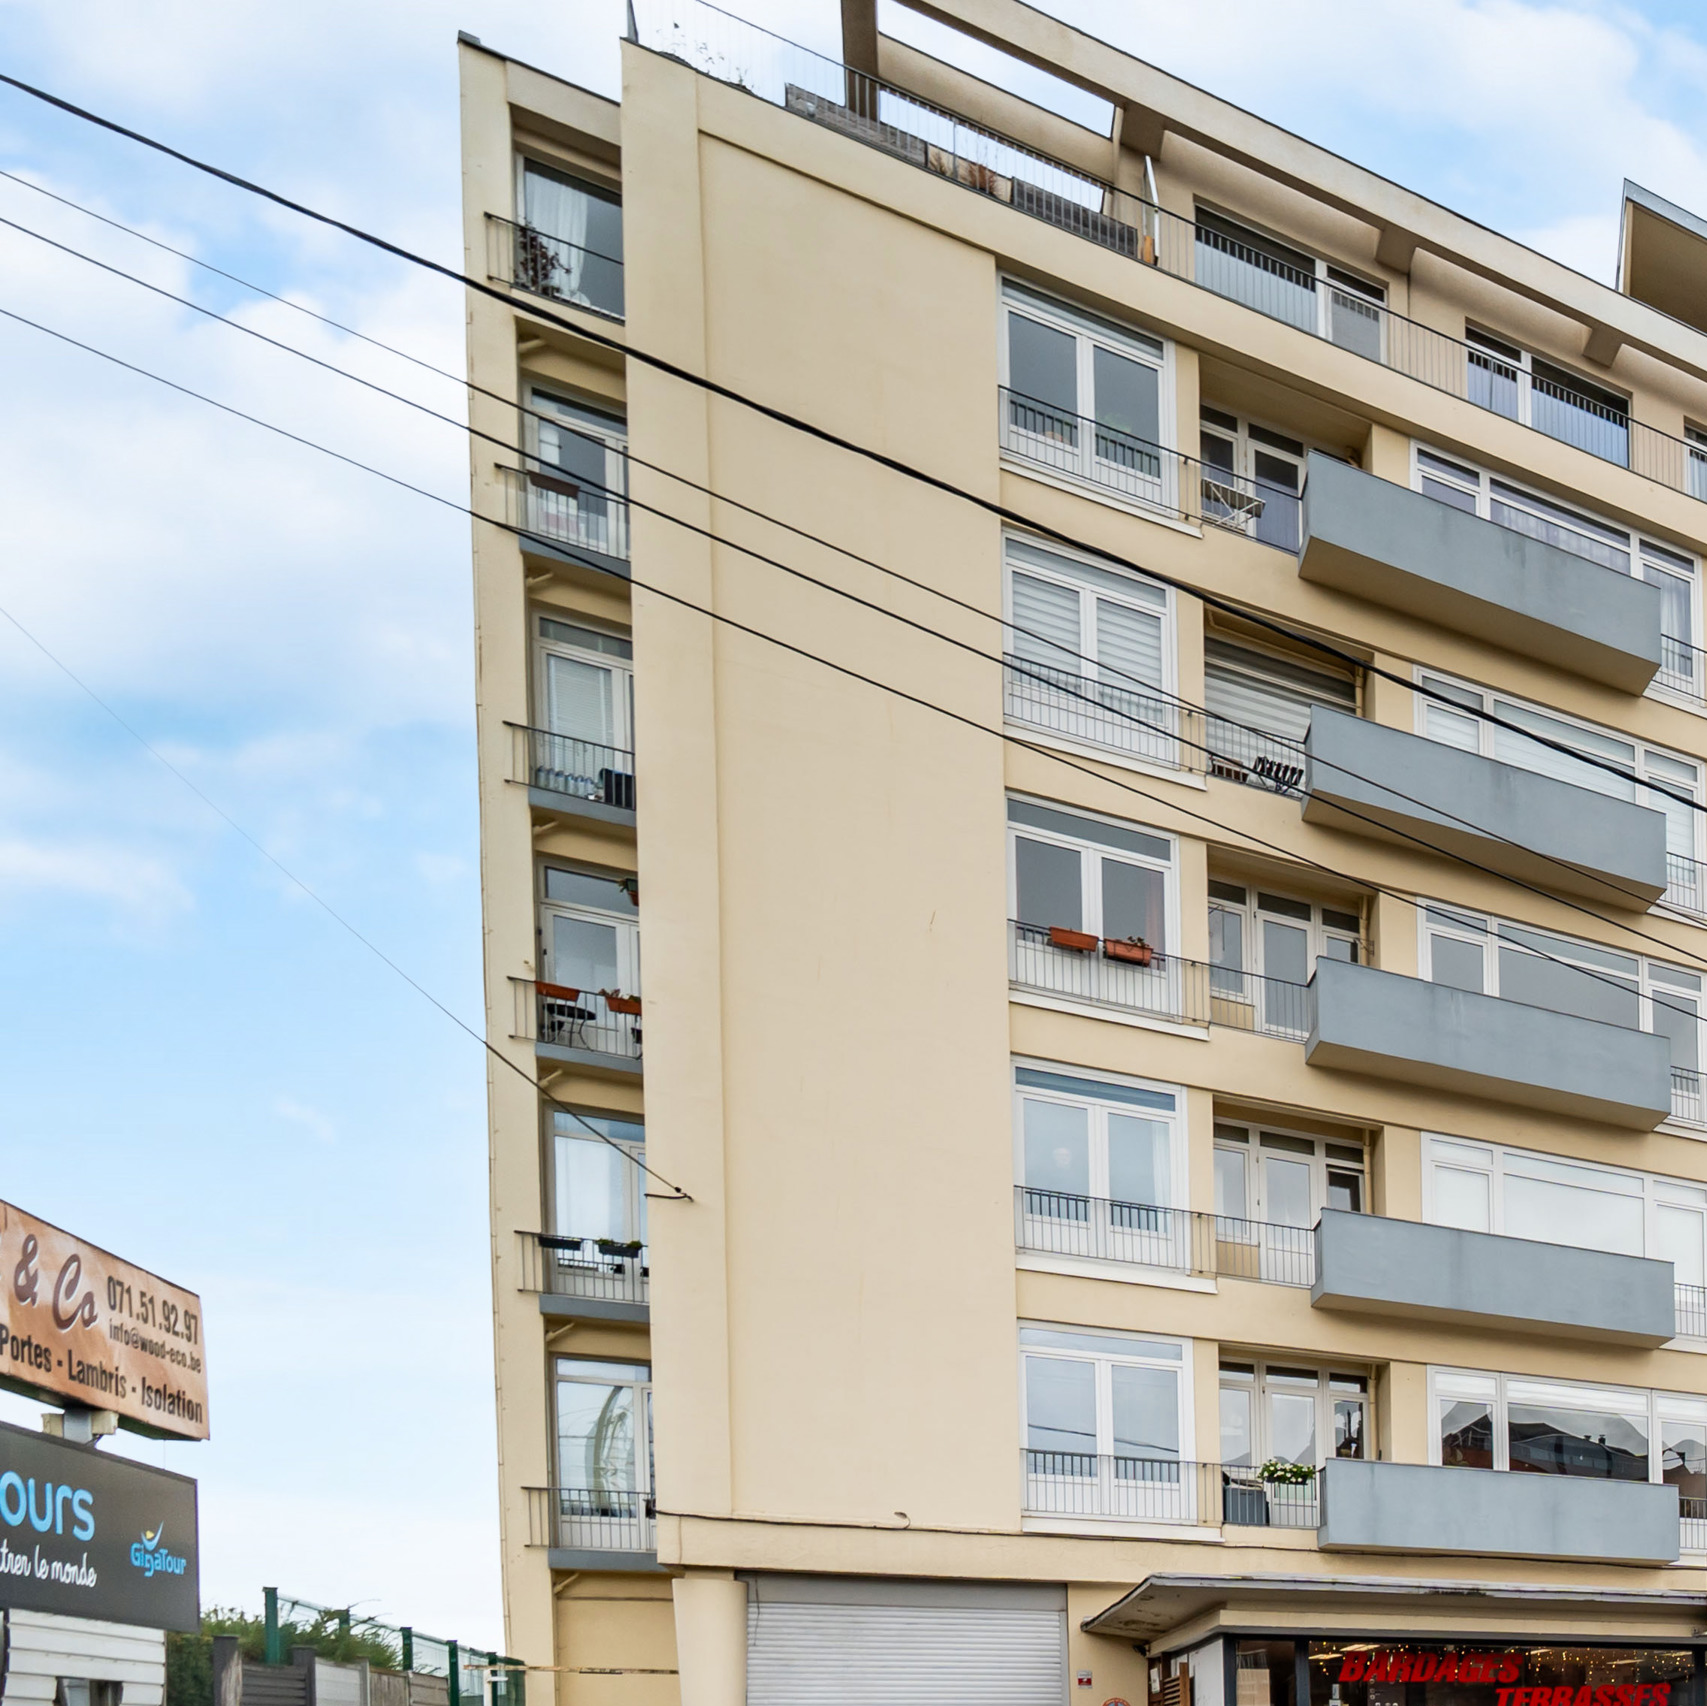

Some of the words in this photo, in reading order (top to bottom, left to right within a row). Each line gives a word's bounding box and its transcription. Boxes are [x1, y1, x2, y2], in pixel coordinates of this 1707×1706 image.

[14, 1234, 38, 1306] &
[53, 1253, 98, 1331] Co
[107, 1275, 198, 1345] 071.51.92.97
[109, 1318, 201, 1373] info@wood-eco.be
[68, 1349, 126, 1398] Lambris
[141, 1376, 202, 1424] Isolation
[51, 1552, 97, 1588] monde
[1338, 1651, 1525, 1683] BARDAGES
